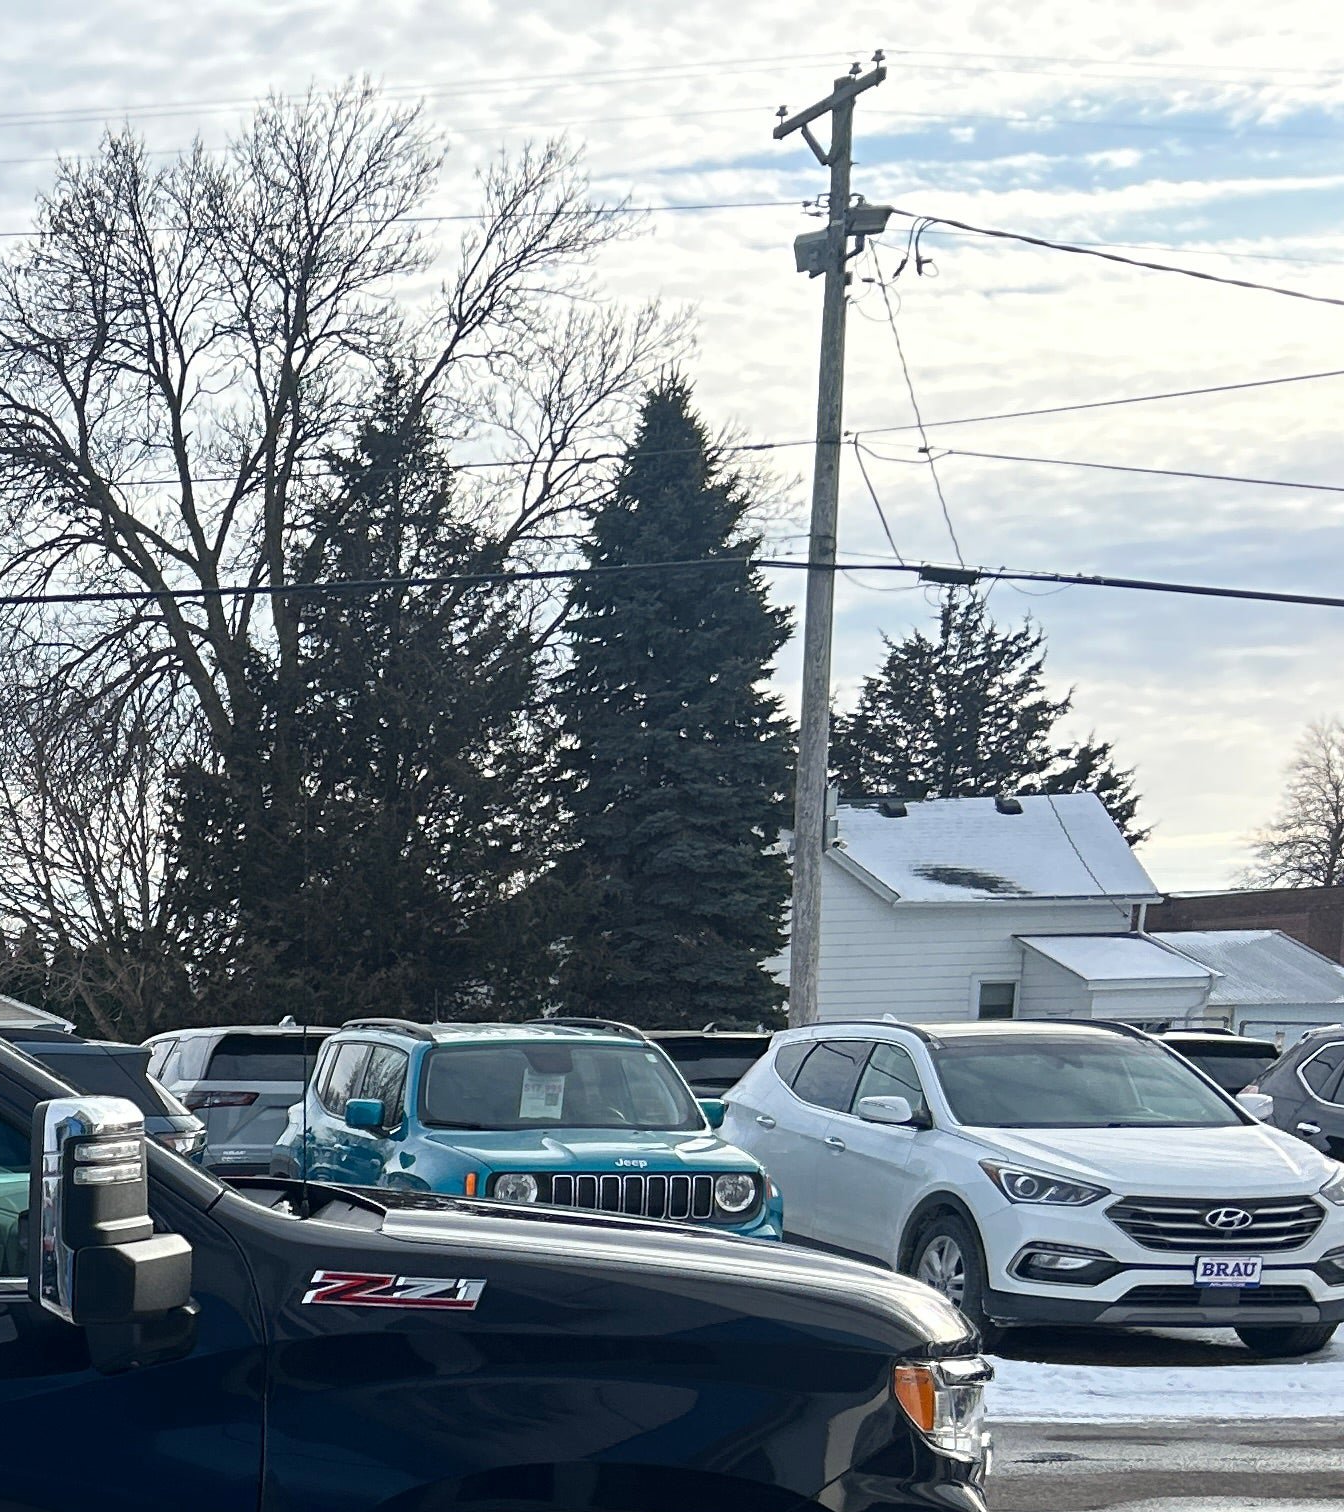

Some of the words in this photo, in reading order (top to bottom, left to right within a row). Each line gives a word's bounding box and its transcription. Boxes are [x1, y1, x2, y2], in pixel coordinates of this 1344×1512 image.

[614, 1158, 648, 1169] Jeep
[1201, 1262, 1258, 1277] BRAU
[301, 1268, 488, 1311] Z71
